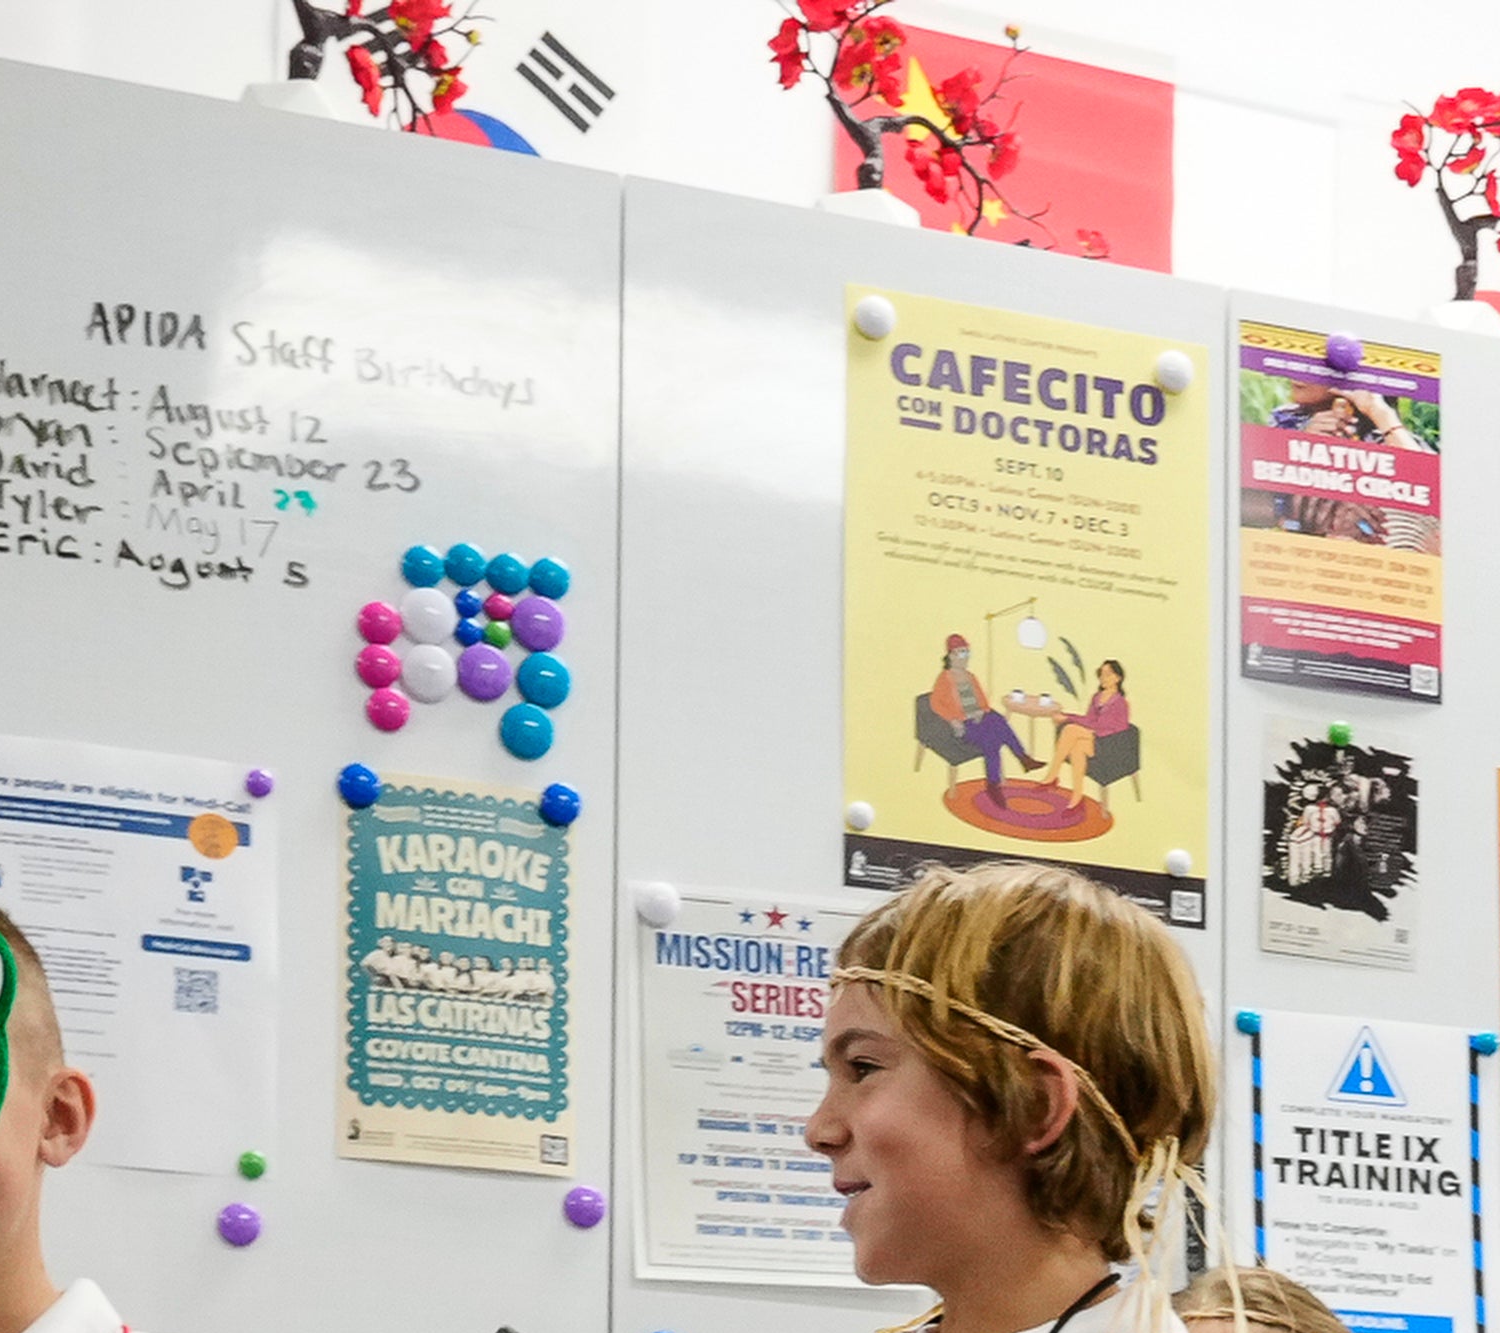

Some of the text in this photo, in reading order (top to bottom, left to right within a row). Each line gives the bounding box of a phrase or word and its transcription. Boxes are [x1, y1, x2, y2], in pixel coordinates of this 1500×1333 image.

[86, 301, 206, 350] APIDA
[231, 321, 334, 374] Staff
[890, 342, 1167, 427] CAFECITO
[289, 409, 329, 443] 12
[896, 395, 1159, 466] CON DOCTORAS
[363, 456, 422, 493] 23
[1287, 438, 1397, 477] NATIVE
[149, 468, 246, 510] April
[1251, 459, 1432, 507] BEADING CIRCLE
[145, 503, 221, 556] May
[237, 519, 281, 558] 17
[375, 833, 553, 894] KARAOKE
[374, 890, 553, 948] MARIACHI
[366, 993, 553, 1041] LAS CATRINAS
[730, 981, 826, 1019] SERIES
[365, 1037, 552, 1075] COYOTE CANTINA
[1293, 1125, 1441, 1164] TITLE IX
[1271, 1156, 1463, 1198] TRAINING
